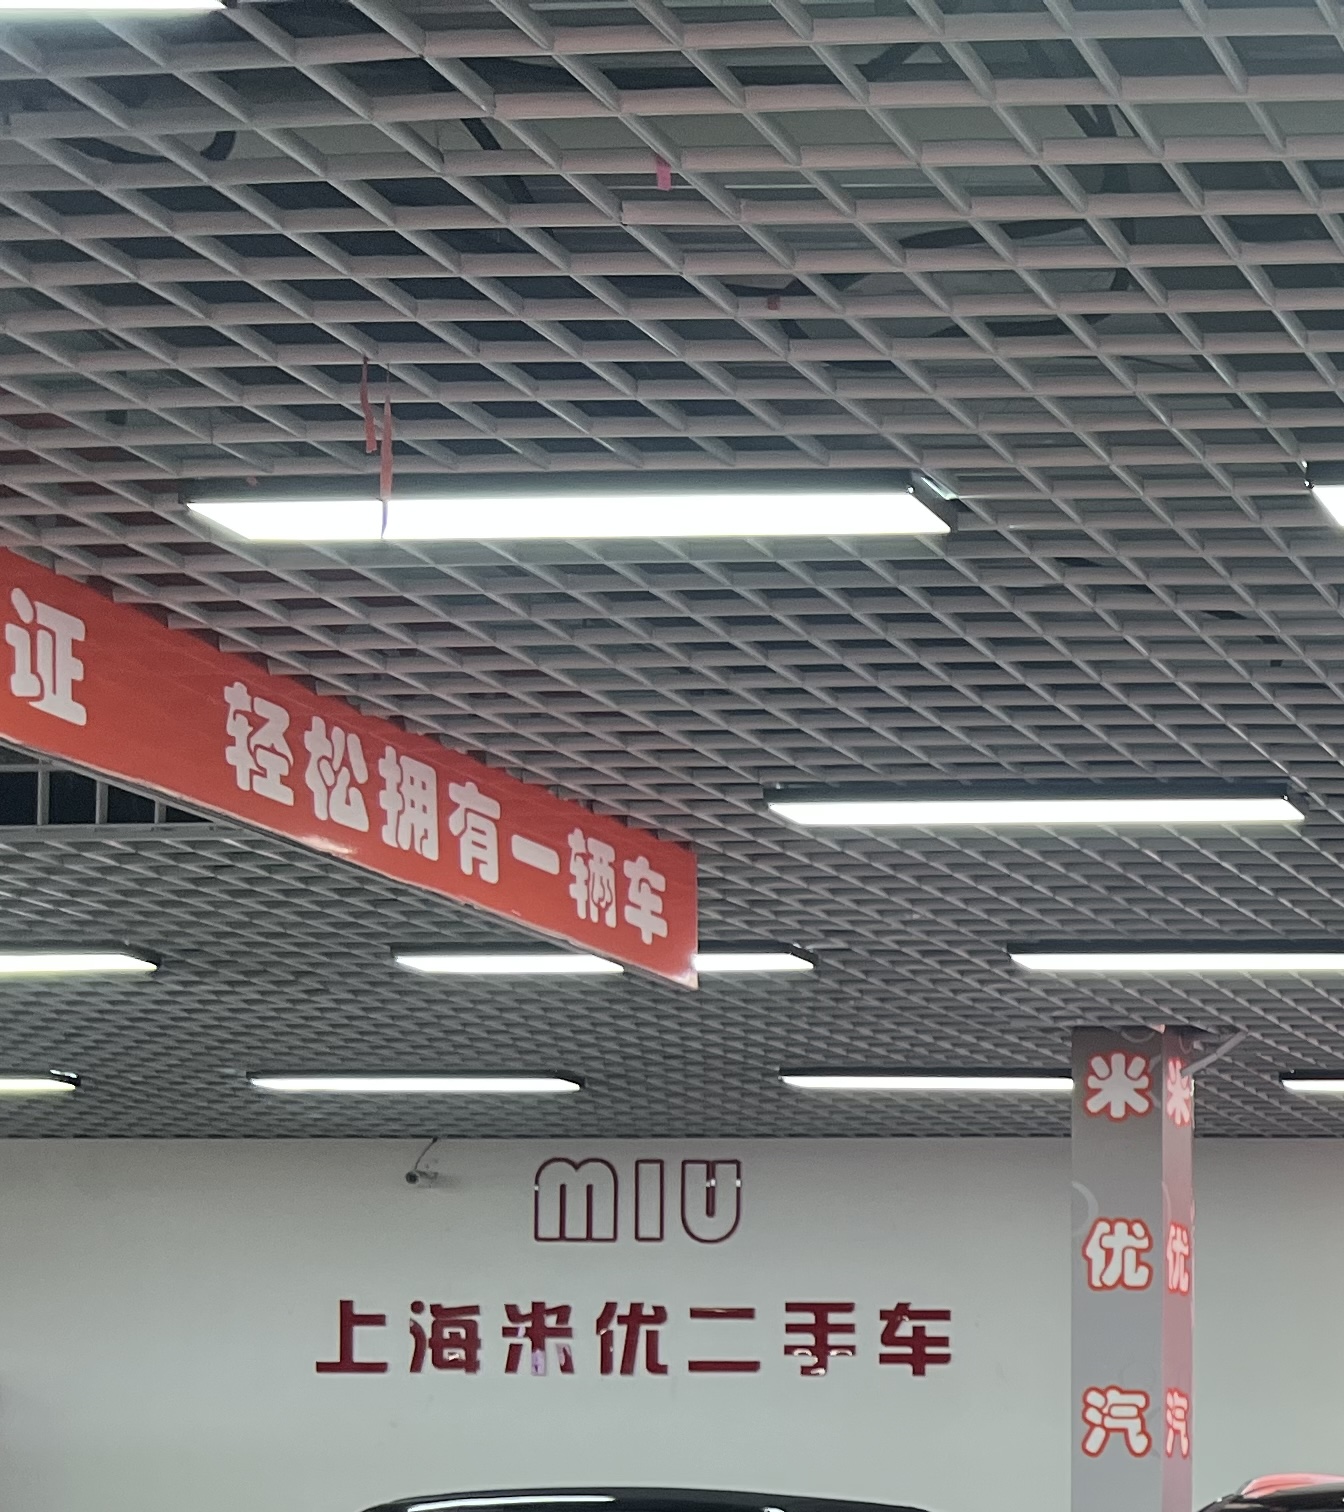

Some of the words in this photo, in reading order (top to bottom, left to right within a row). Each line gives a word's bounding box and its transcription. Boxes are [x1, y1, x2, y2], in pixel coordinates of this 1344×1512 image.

[5, 587, 87, 726] 证
[223, 681, 669, 945] 轻松拥有一辆车
[314, 1299, 953, 1377] 上海米优二手车
